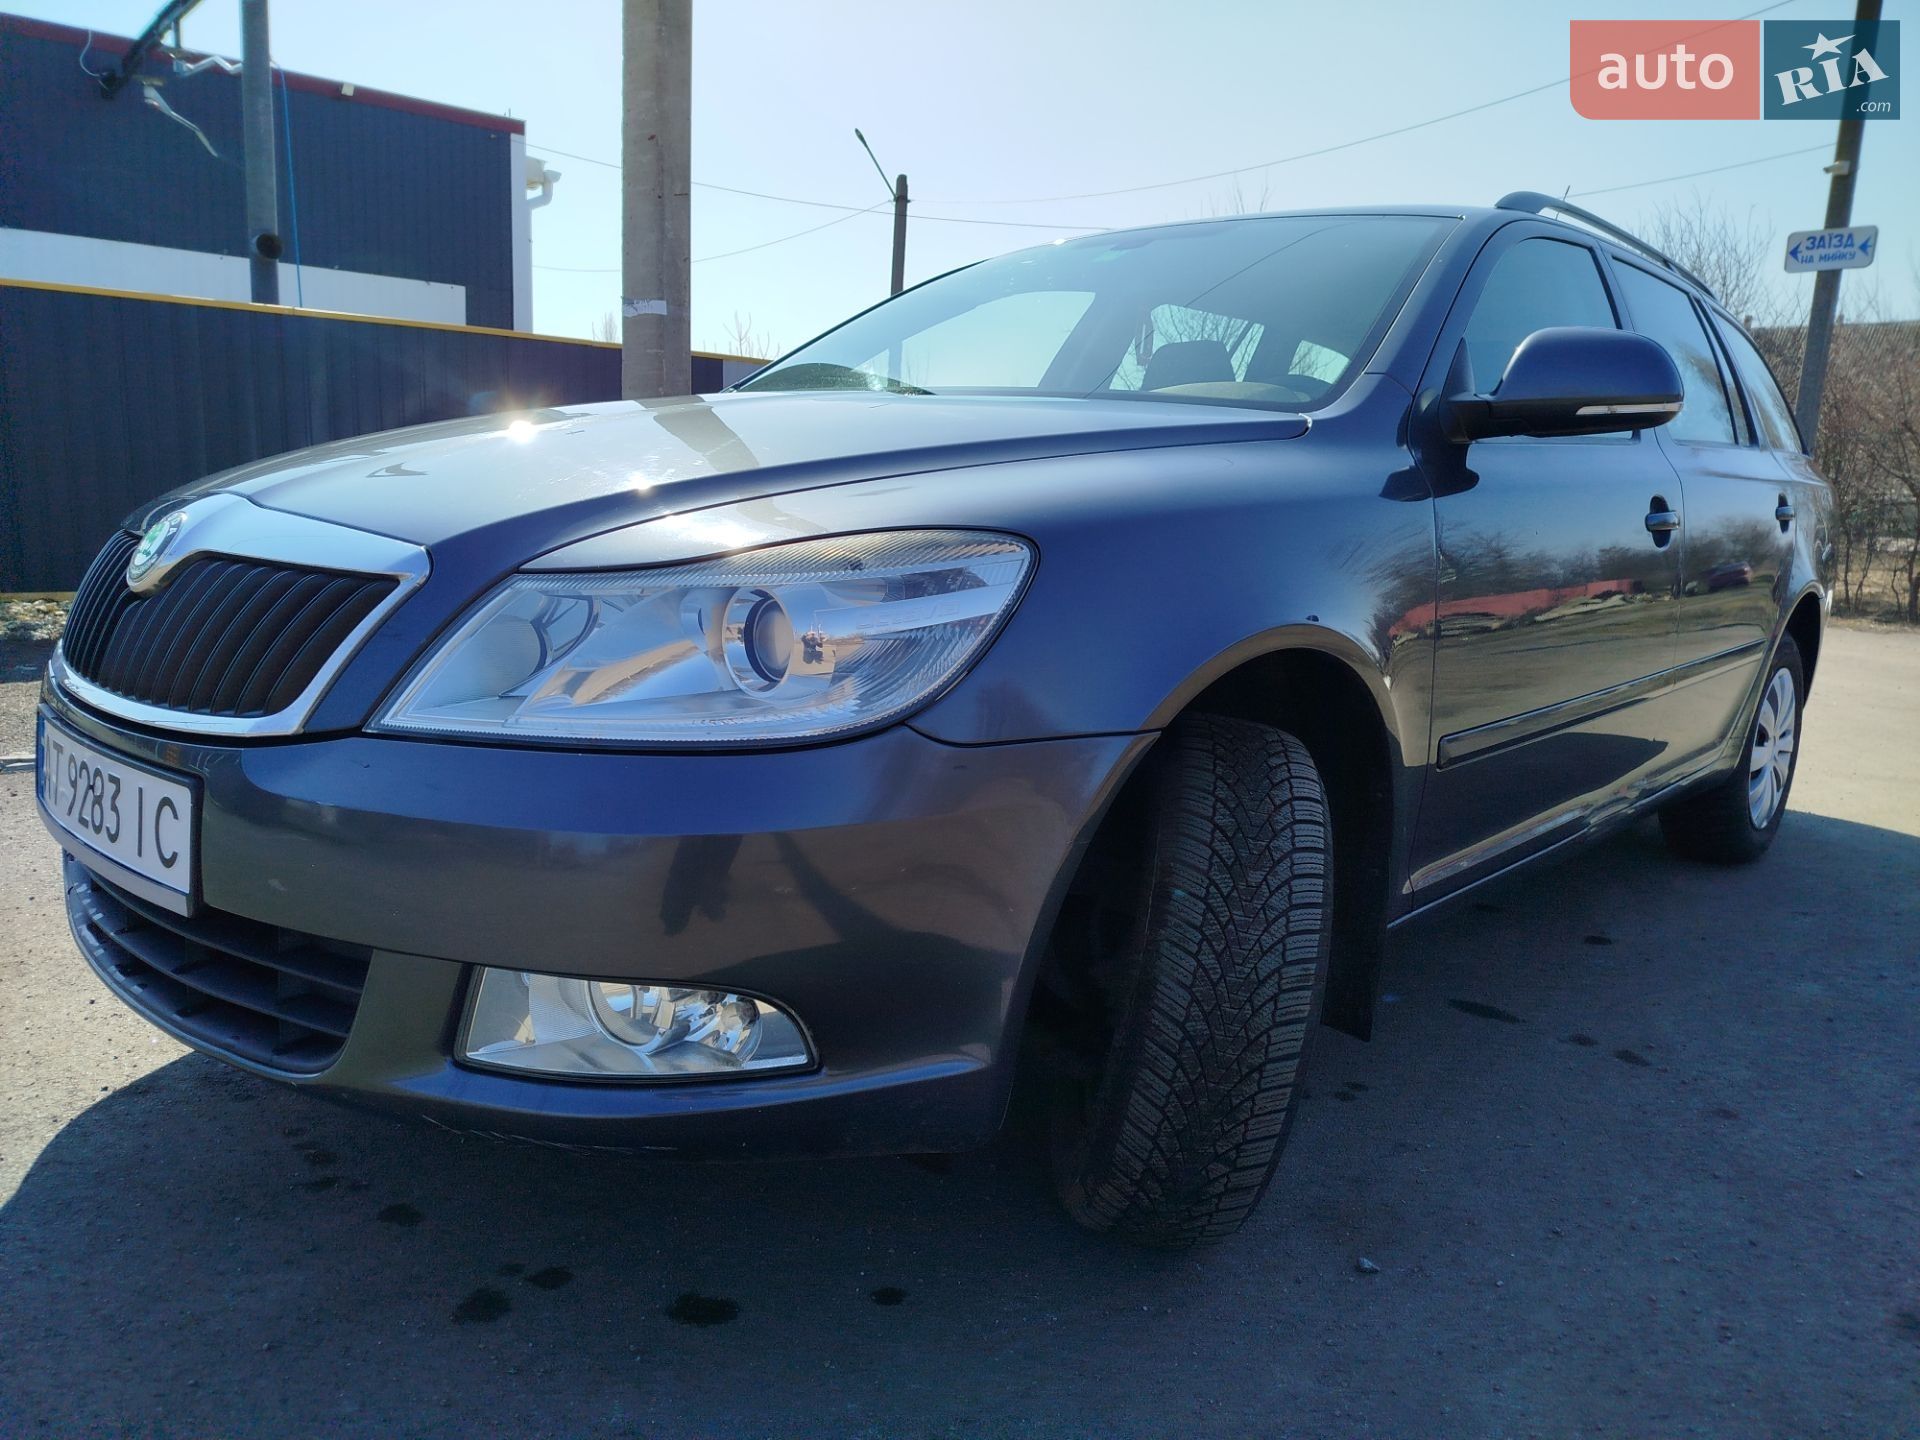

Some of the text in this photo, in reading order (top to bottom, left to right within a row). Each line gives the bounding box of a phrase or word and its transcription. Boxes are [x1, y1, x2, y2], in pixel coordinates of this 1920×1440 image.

[1805, 232, 1855, 251] ЗАЇЗД
[1800, 250, 1857, 264] НА МИЙКУ
[66, 753, 121, 843] 9283
[137, 787, 179, 869] IC
